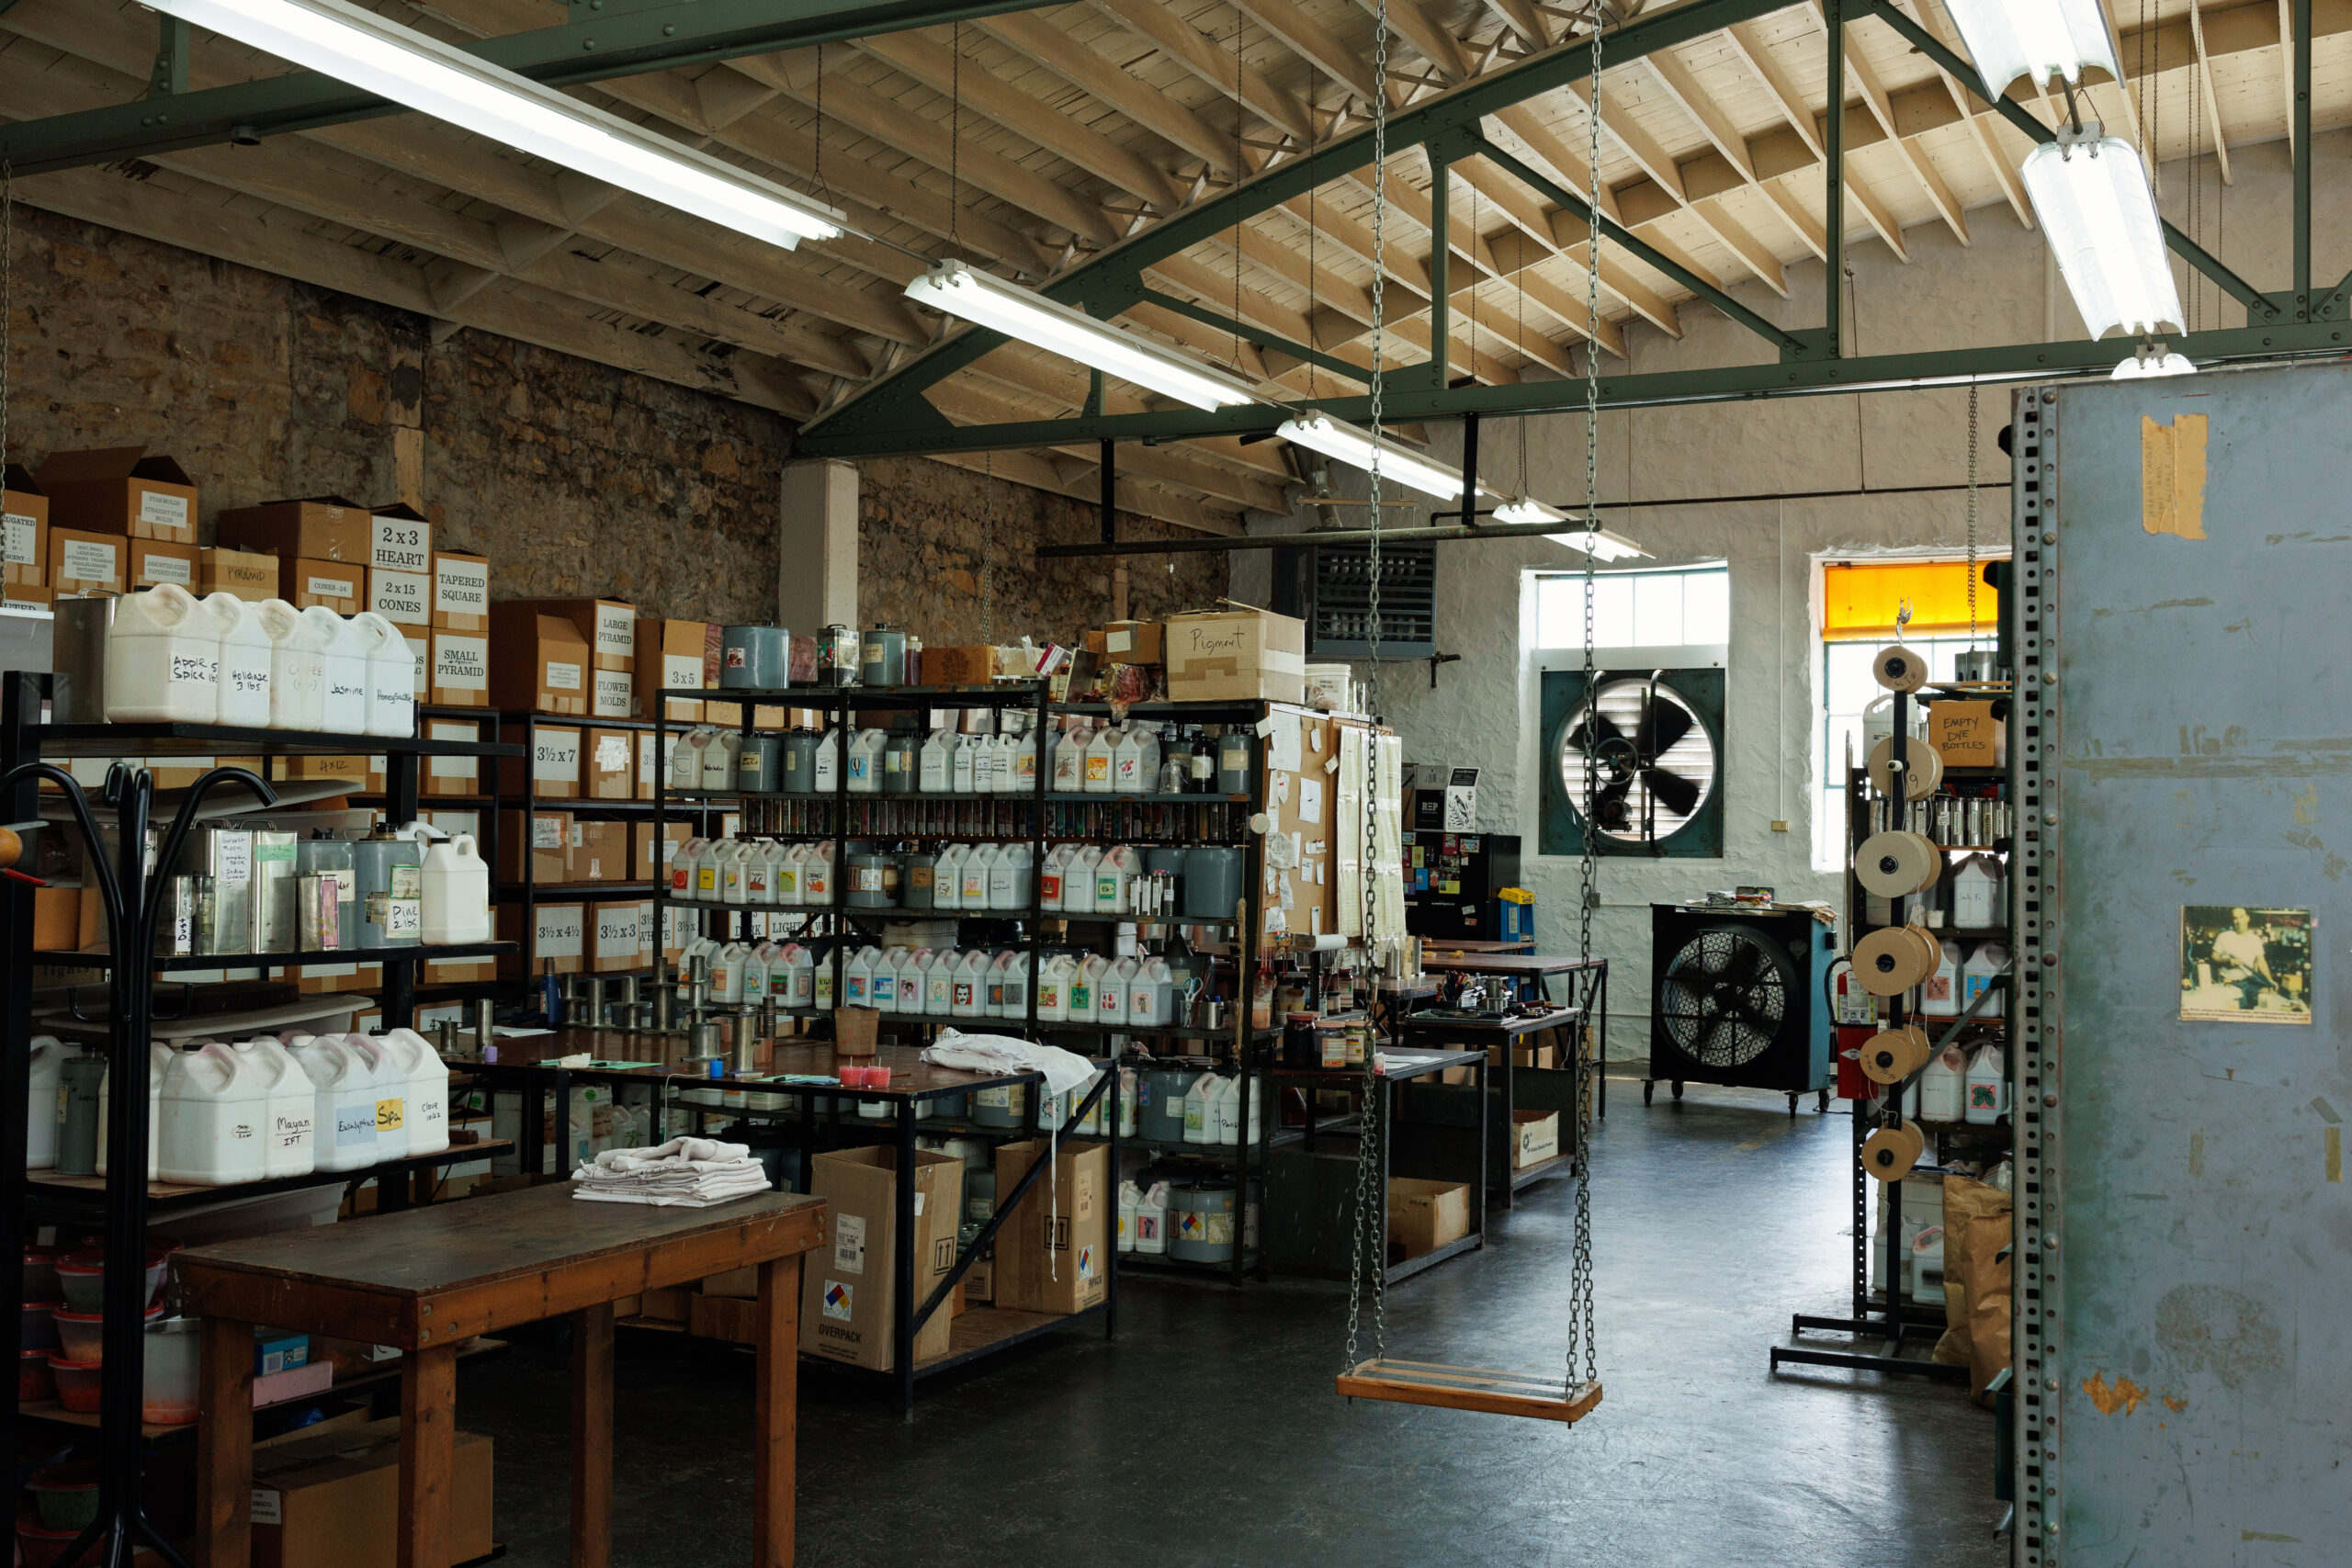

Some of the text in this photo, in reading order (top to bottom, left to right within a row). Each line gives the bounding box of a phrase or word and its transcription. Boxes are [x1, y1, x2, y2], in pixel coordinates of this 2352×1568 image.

[383, 527, 418, 546] 2 x 3
[376, 549, 424, 566] HEART
[228, 567, 265, 581] PYRAMID
[314, 582, 335, 591] CONES
[439, 574, 485, 588] TAPERED
[386, 582, 415, 595] 2 x 15
[442, 590, 481, 603] SQUARE
[379, 598, 421, 612] CONES
[603, 618, 628, 630] LARGE
[598, 632, 632, 645] PYRAMID
[444, 649, 478, 661] SMALL
[437, 664, 484, 677] PYRAMID
[673, 671, 695, 684] 3 x 5
[236, 682, 243, 691] 3
[598, 681, 629, 693] FLOWER
[600, 696, 627, 707] MOLDS
[1943, 716, 1980, 729] EMPTY
[1948, 729, 1970, 741] DYE
[1942, 741, 1985, 750] BOTTLES
[558, 751, 566, 761] x
[569, 749, 576, 762] 7
[620, 928, 628, 938] x
[629, 924, 636, 937] 3
[772, 921, 803, 933] LIGHT
[557, 930, 563, 938] x
[639, 931, 670, 942] WHTE
[378, 1106, 401, 1125] Spa
[277, 1117, 310, 1134] Mayan
[819, 1324, 862, 1344] OVERPACK
